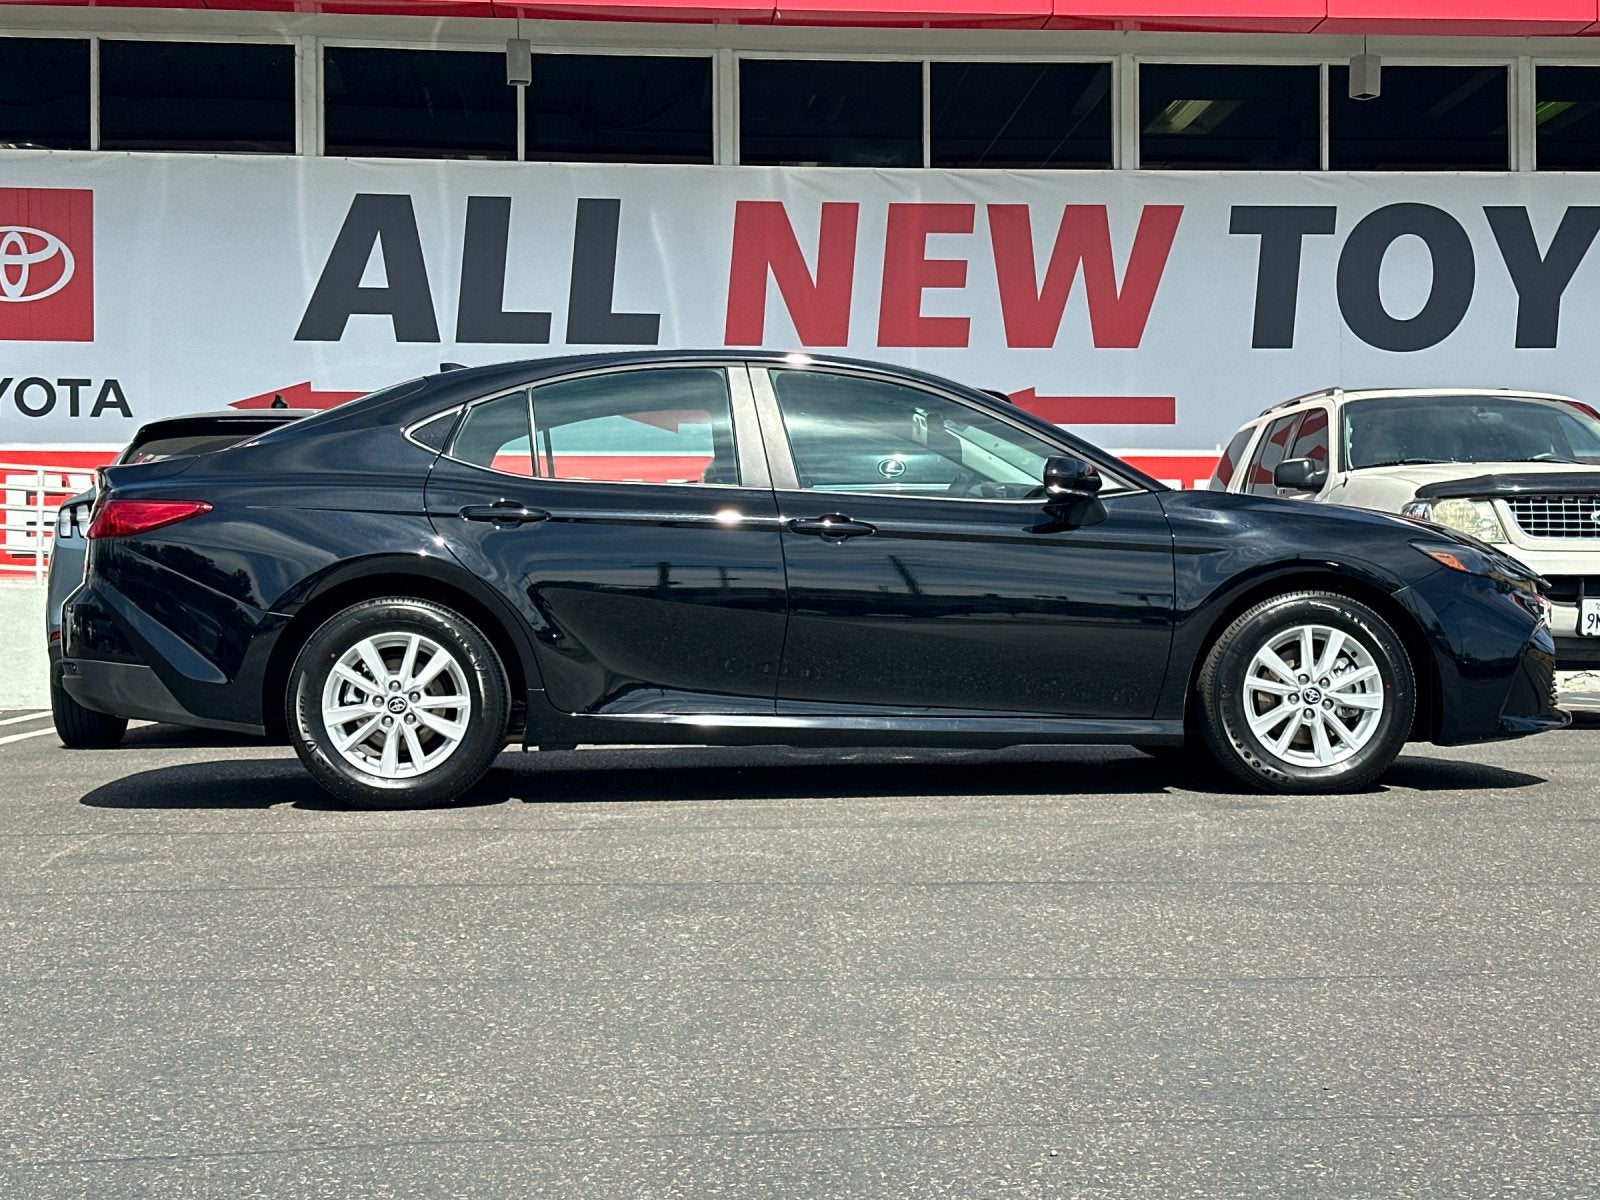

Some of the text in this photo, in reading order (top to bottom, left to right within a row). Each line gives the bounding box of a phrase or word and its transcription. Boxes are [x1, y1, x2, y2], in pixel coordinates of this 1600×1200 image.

[294, 194, 1600, 352] ALL NEW TOY
